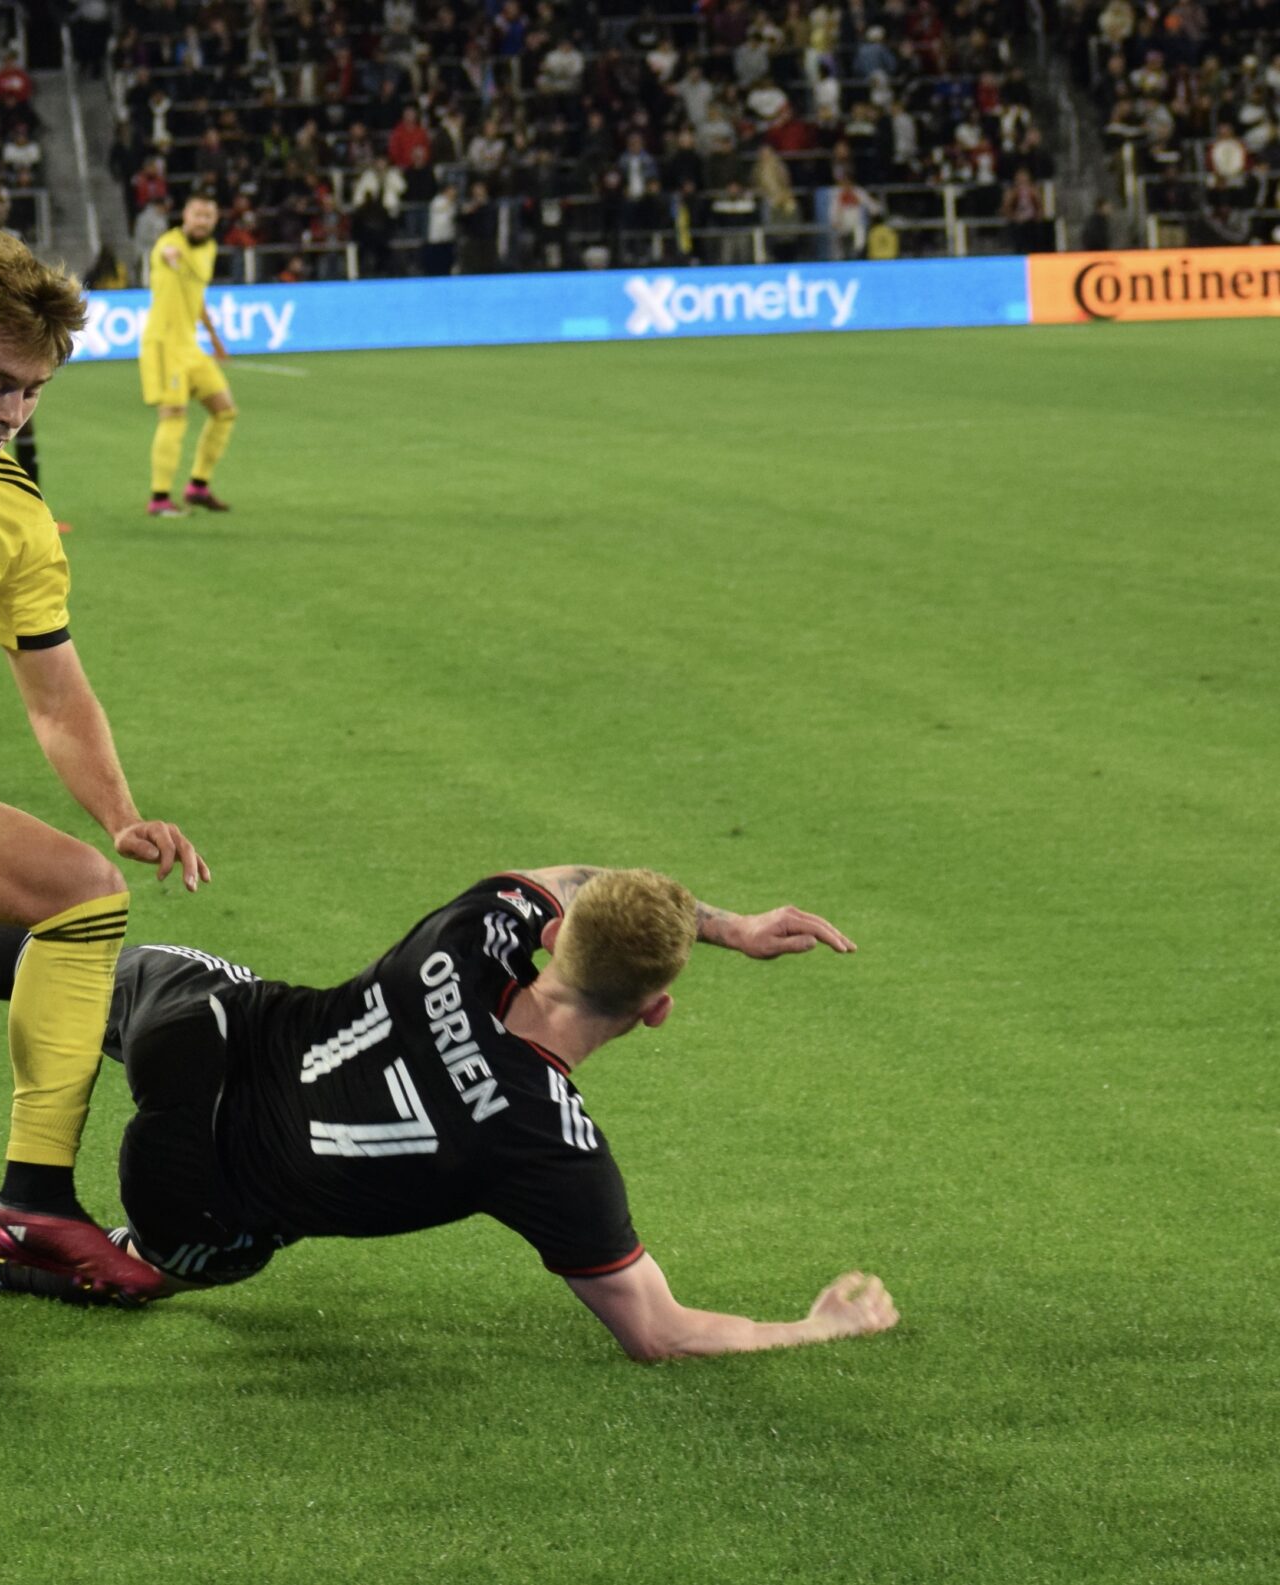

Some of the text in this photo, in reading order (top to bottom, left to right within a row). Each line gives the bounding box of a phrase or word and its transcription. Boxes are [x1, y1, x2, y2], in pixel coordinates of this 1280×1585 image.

[624, 270, 860, 335] Xometry
[300, 982, 439, 1157] 17
[420, 950, 510, 1123] O'BRIEN
